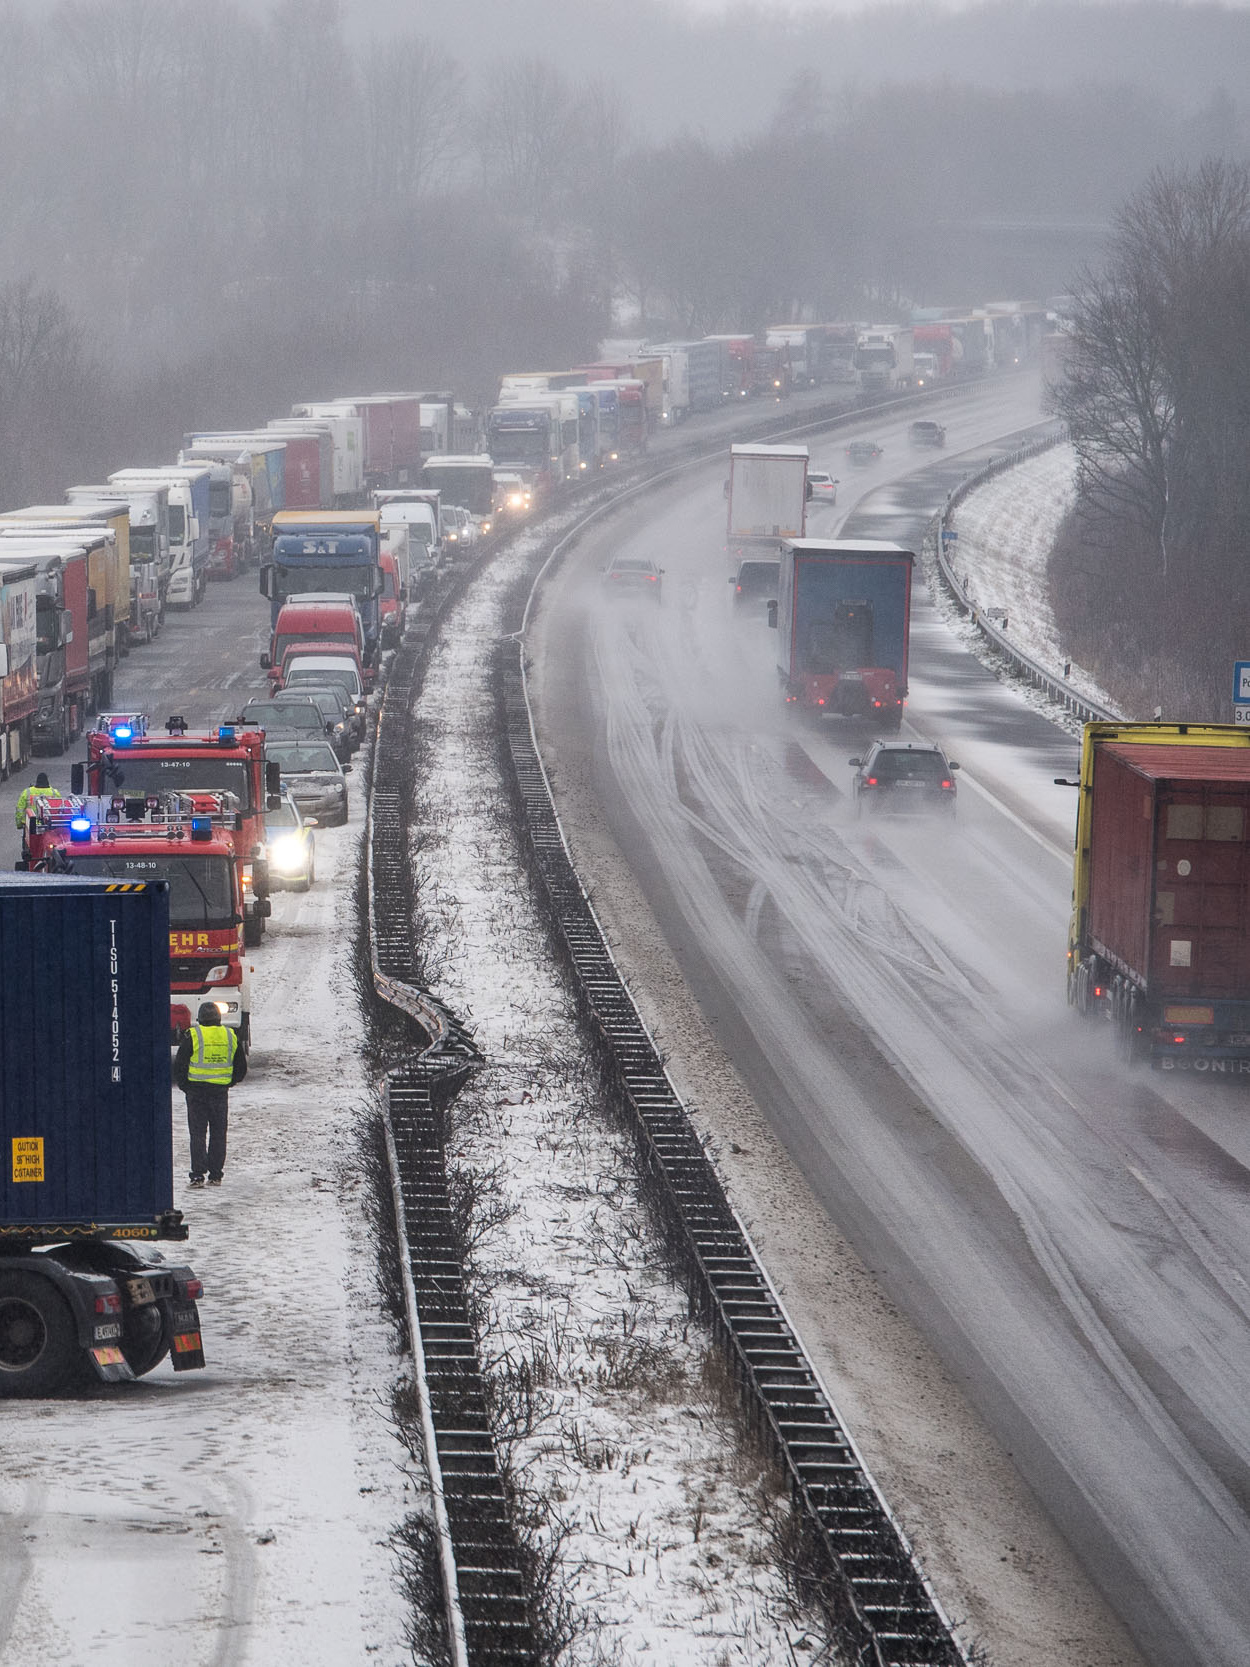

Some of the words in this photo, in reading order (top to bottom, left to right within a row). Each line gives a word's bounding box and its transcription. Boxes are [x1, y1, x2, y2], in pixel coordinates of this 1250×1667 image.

[302, 540, 339, 554] S&T
[110, 919, 118, 975] TISU
[111, 979, 119, 1062] 514052
[112, 1067, 119, 1081] 4
[25, 1154, 40, 1164] HIGH
[112, 1227, 149, 1238] 4060
